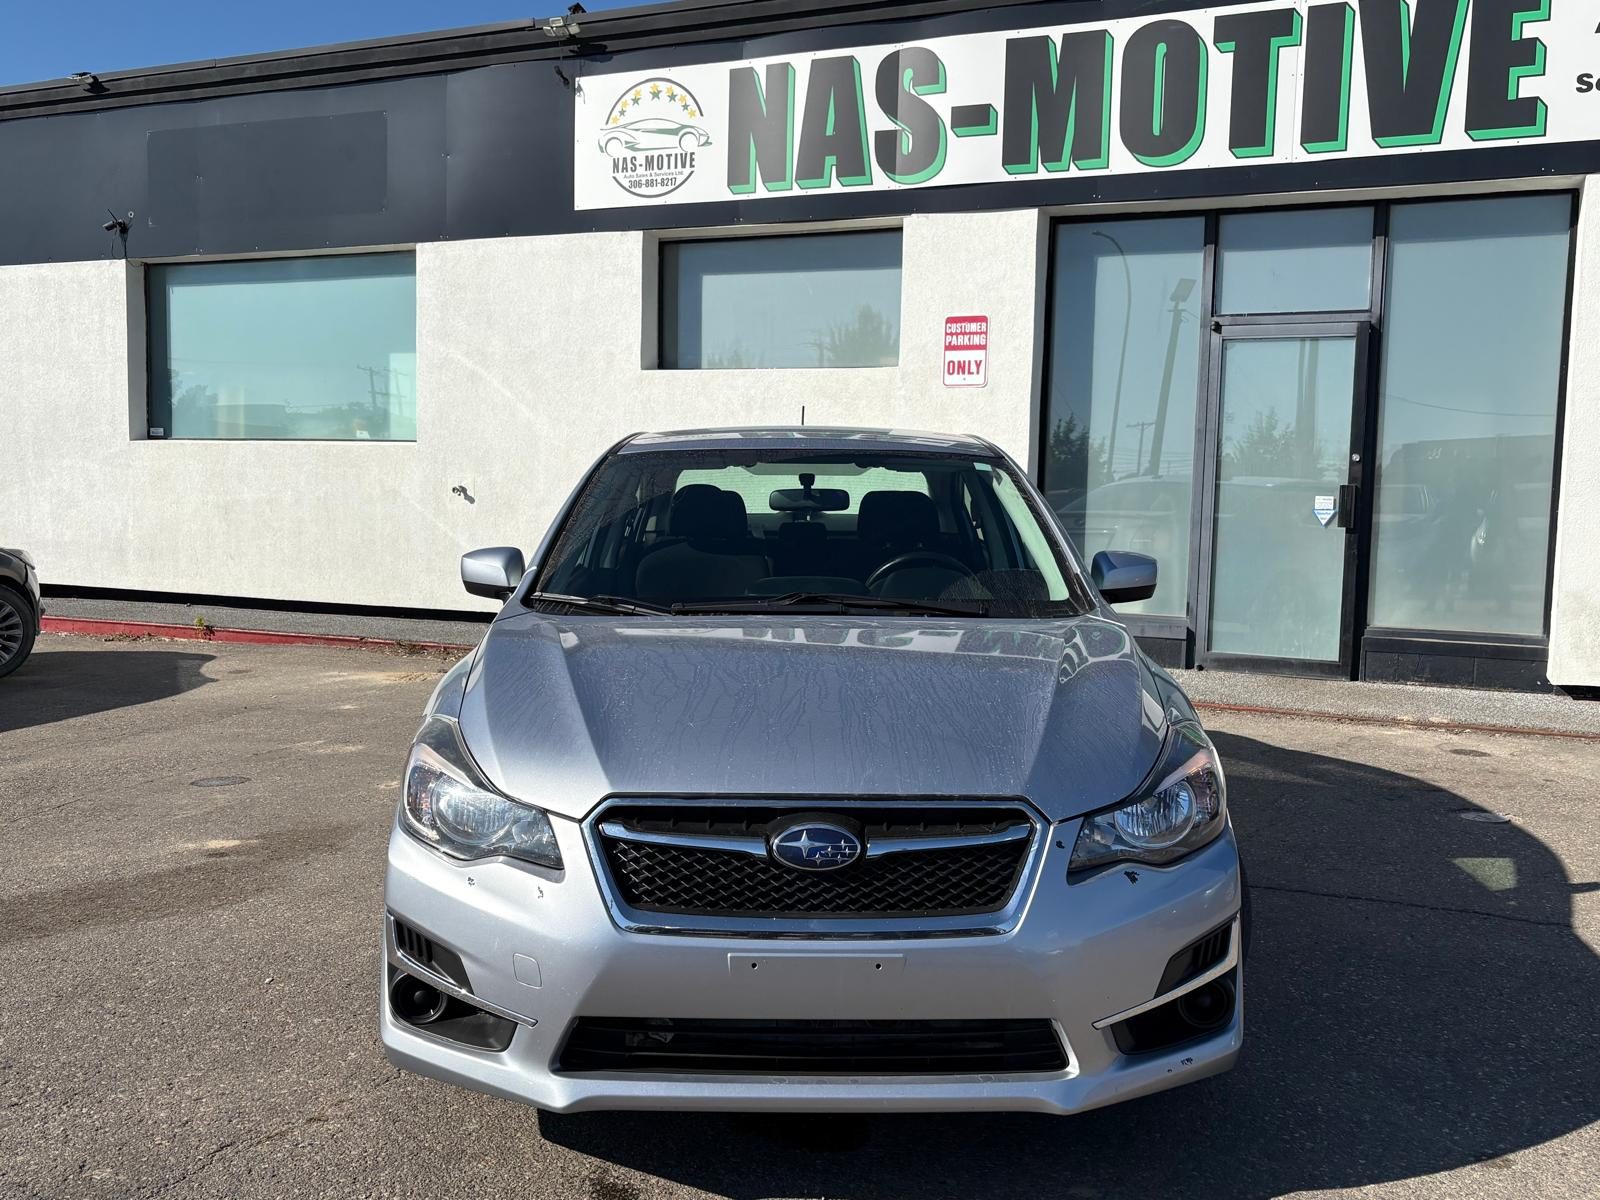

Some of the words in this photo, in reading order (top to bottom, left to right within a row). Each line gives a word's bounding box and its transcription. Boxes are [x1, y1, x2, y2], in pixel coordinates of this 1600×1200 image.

[727, 0, 1552, 195] NAS-MOTIVE
[612, 151, 696, 174] NAS-MOTIVE
[946, 322, 987, 333] CUSTOMER
[945, 334, 987, 346] PARKING
[947, 360, 983, 375] ONLY
